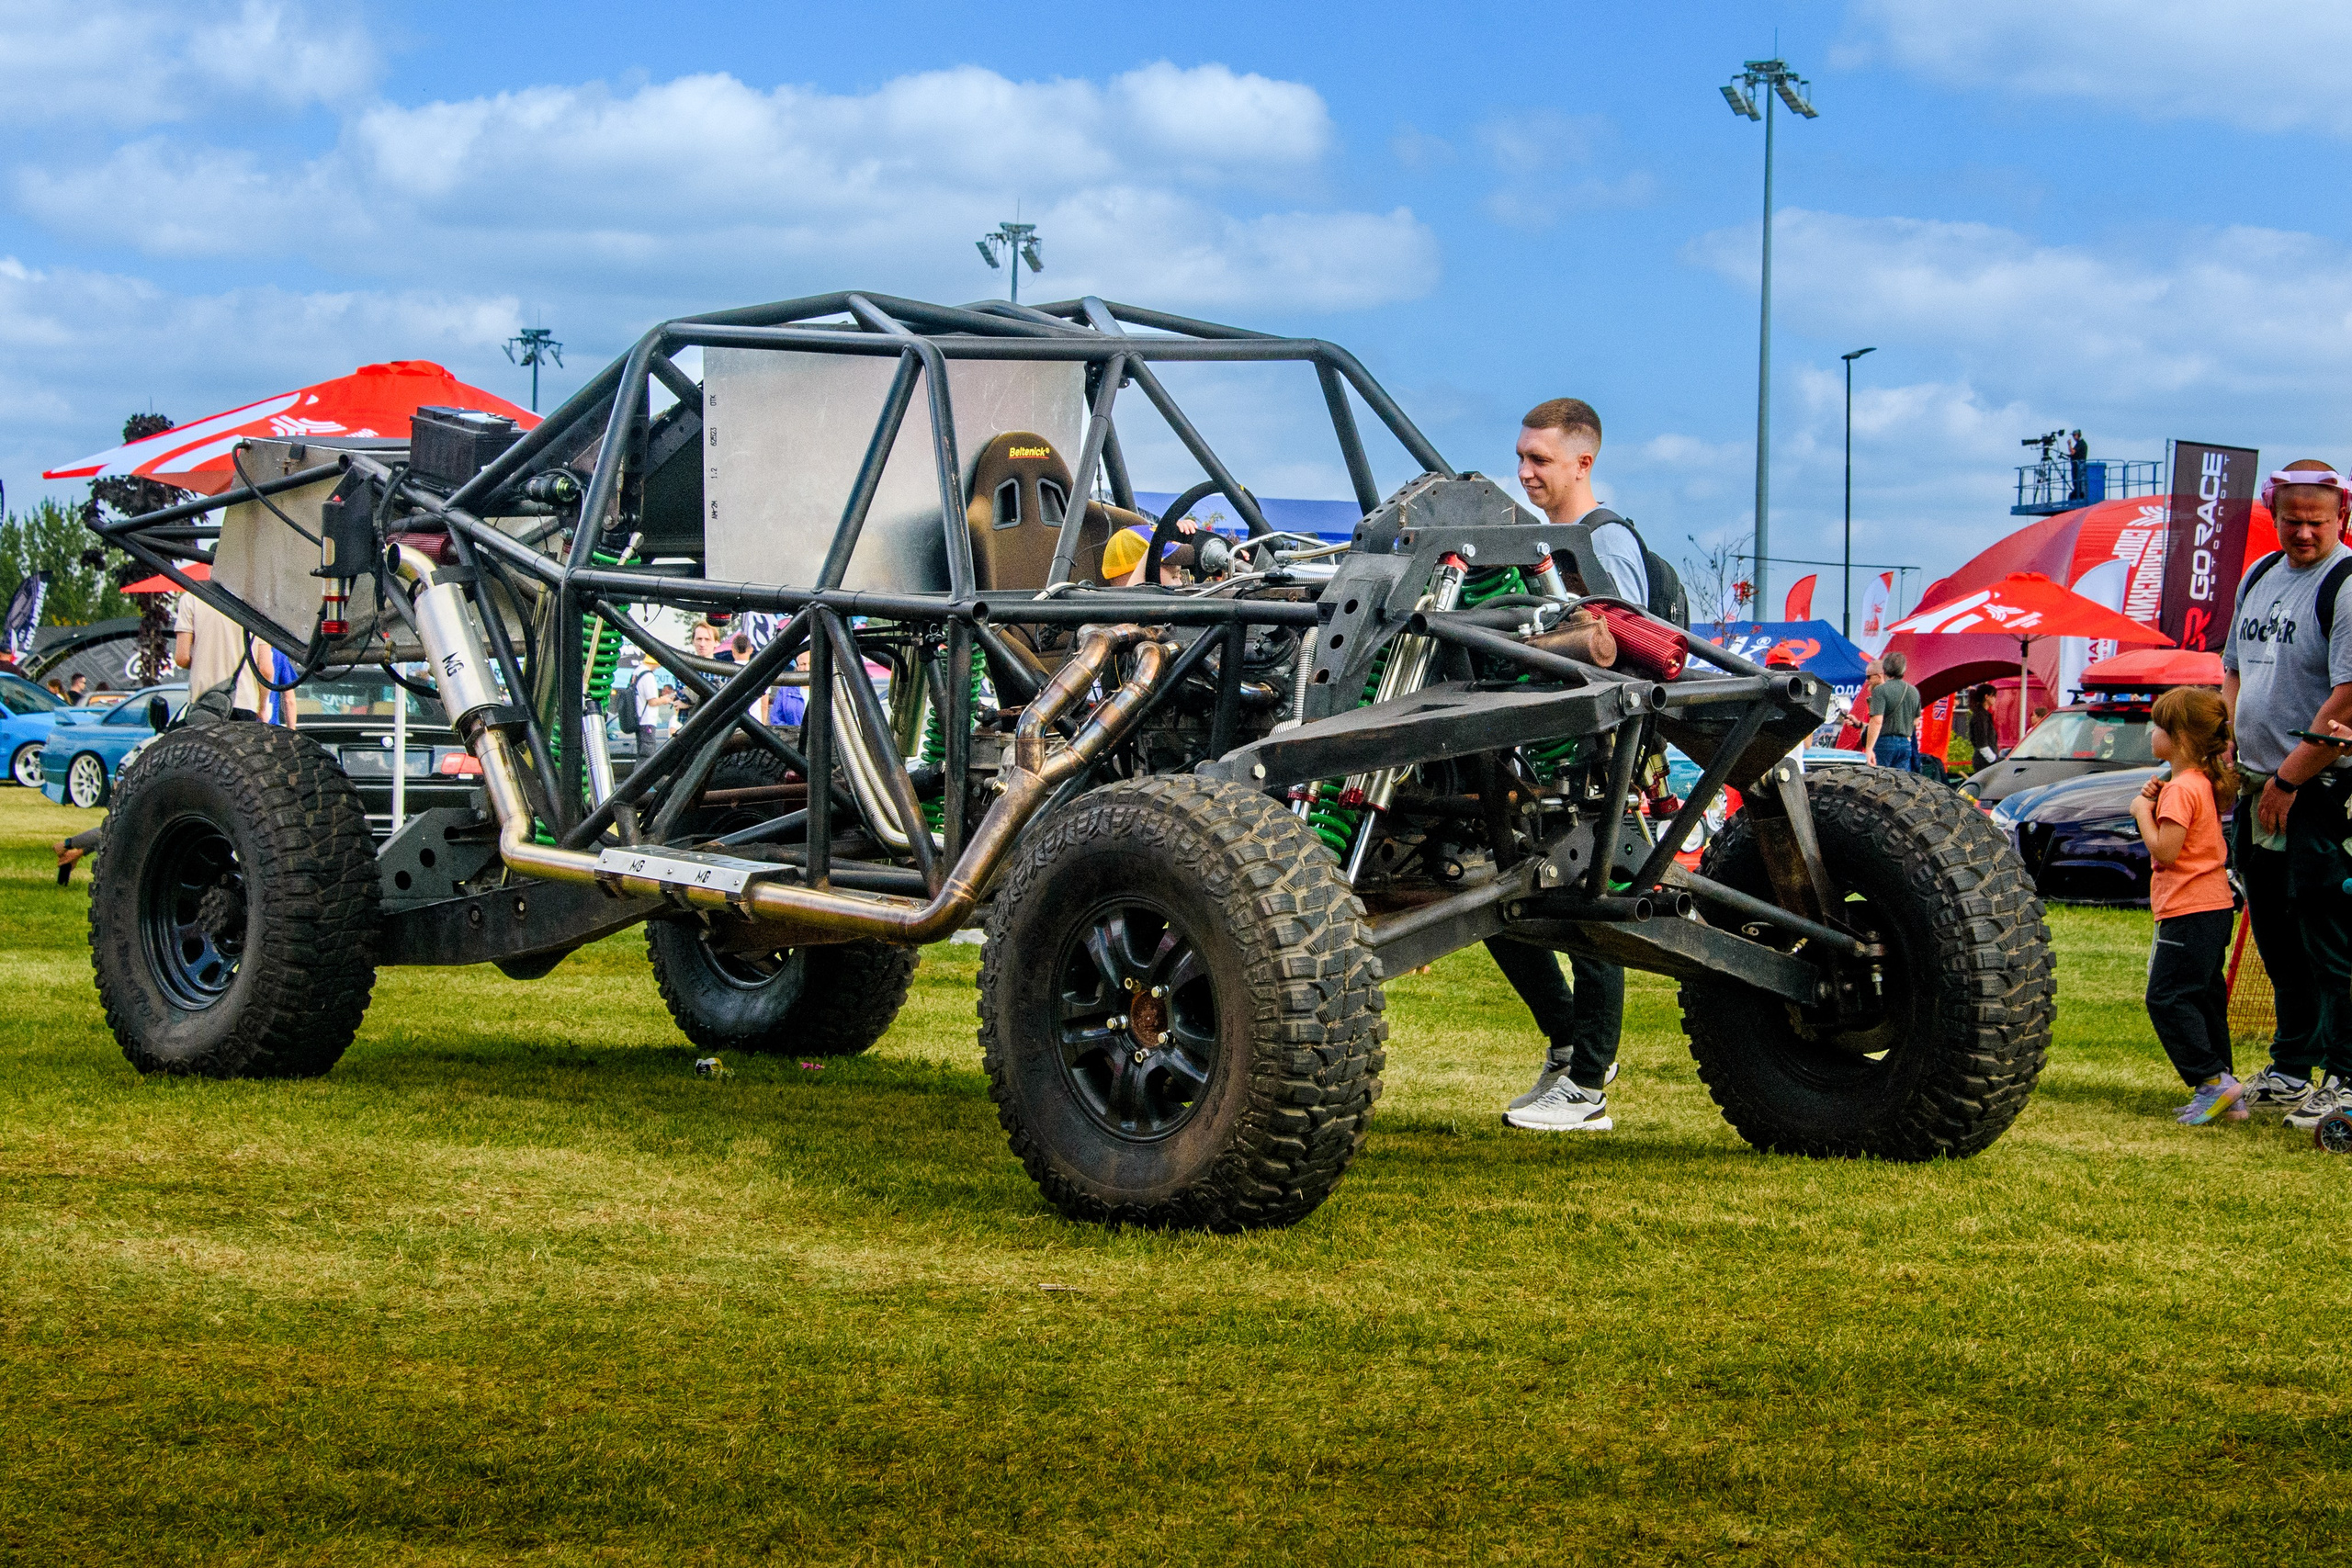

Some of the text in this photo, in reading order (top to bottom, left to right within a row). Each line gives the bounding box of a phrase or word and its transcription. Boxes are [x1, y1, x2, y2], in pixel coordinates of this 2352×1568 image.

[2189, 451, 2223, 601] GO RACE
[2239, 617, 2297, 645] ROCER
[442, 651, 465, 677] MG
[629, 859, 712, 884] MG MG
